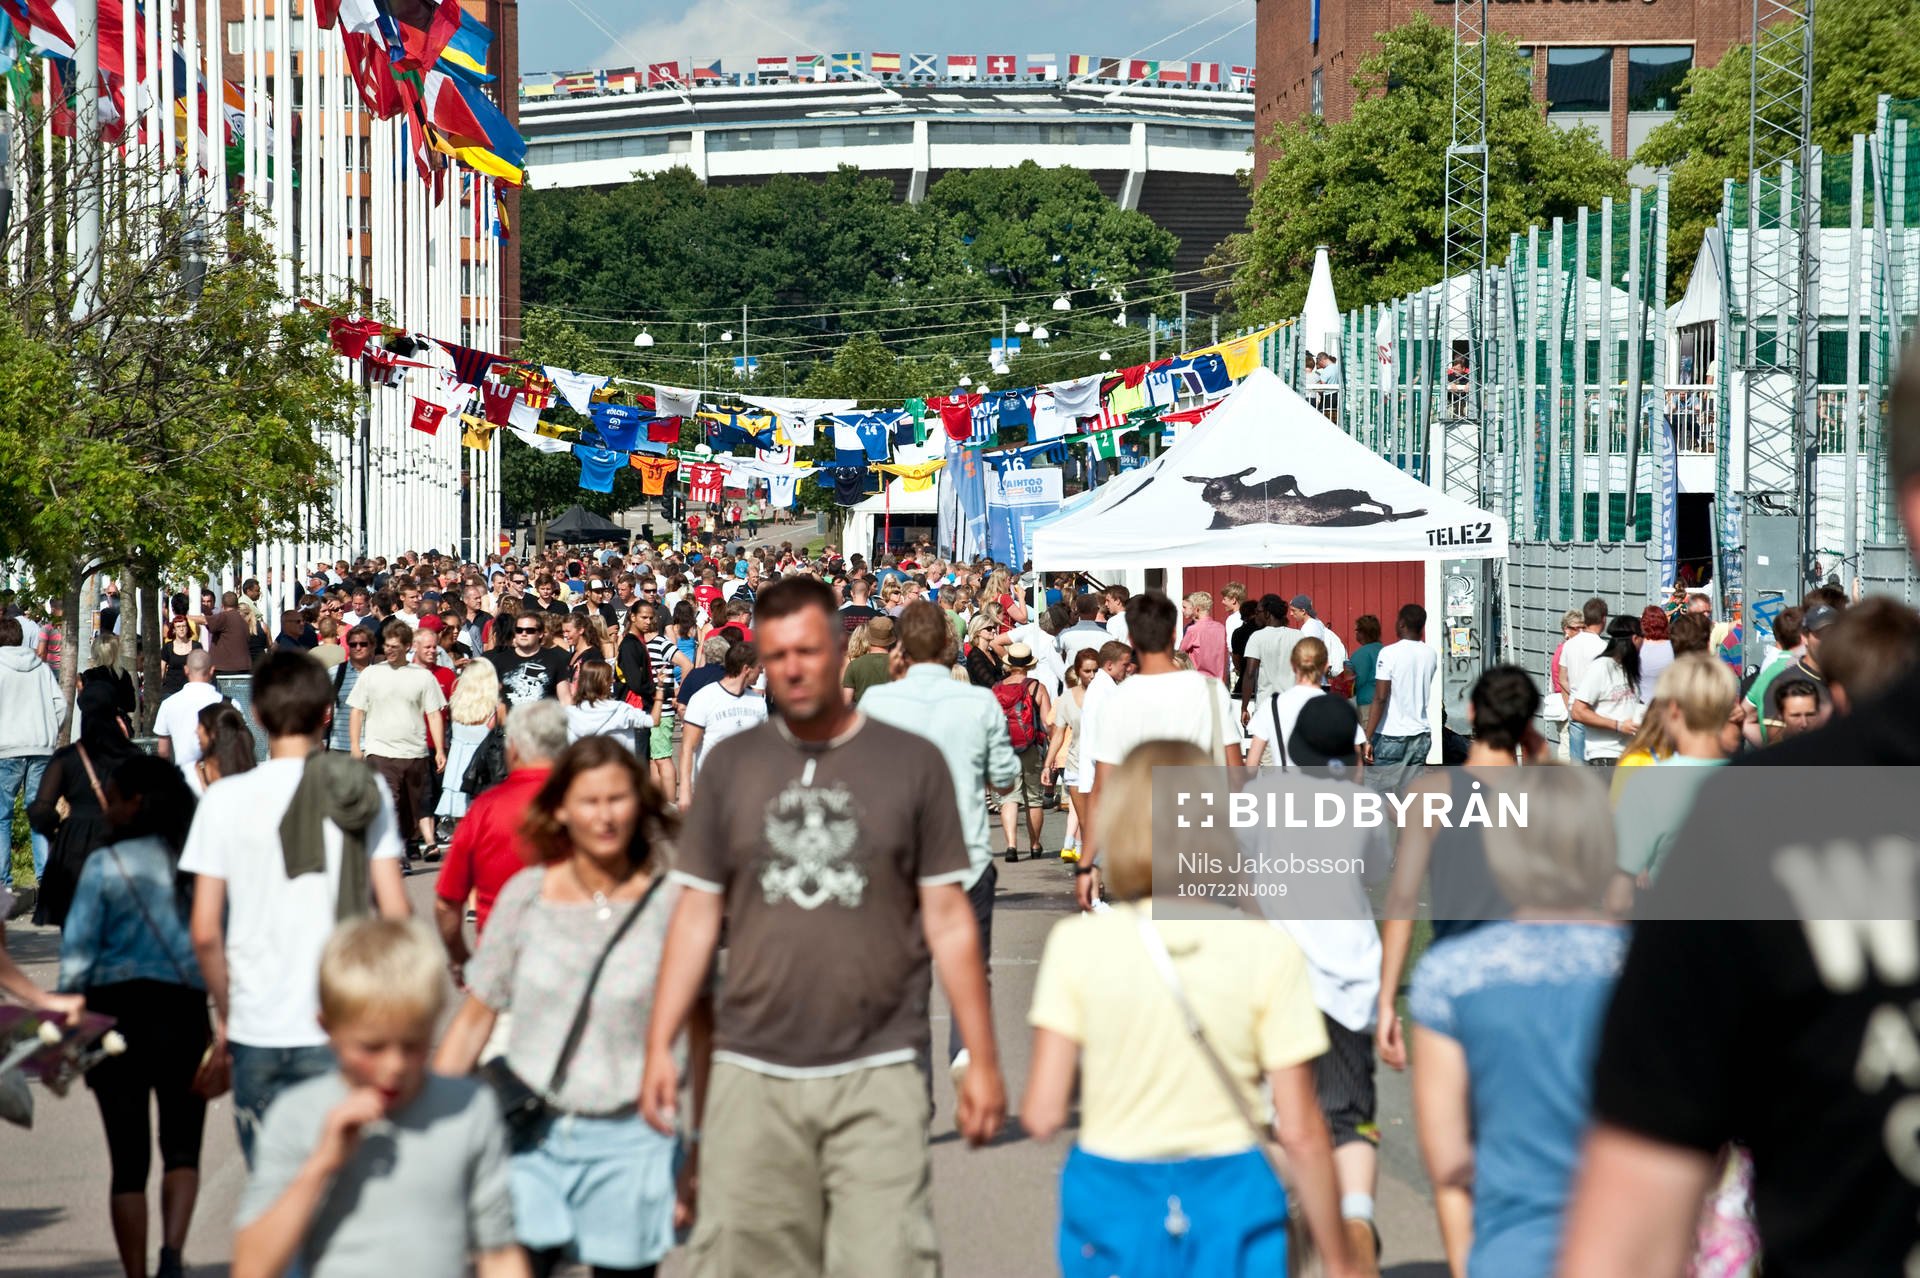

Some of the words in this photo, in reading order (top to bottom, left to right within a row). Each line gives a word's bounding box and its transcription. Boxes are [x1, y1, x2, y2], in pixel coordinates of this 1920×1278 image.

[1209, 359, 1218, 372] 9
[1152, 372, 1168, 386] 10
[423, 405, 434, 417] 9
[865, 425, 877, 435] 14
[1100, 432, 1109, 447] 2
[1001, 457, 1026, 472] 16
[698, 470, 713, 484] 36
[775, 475, 789, 486] 17
[1426, 522, 1492, 546] TELE2
